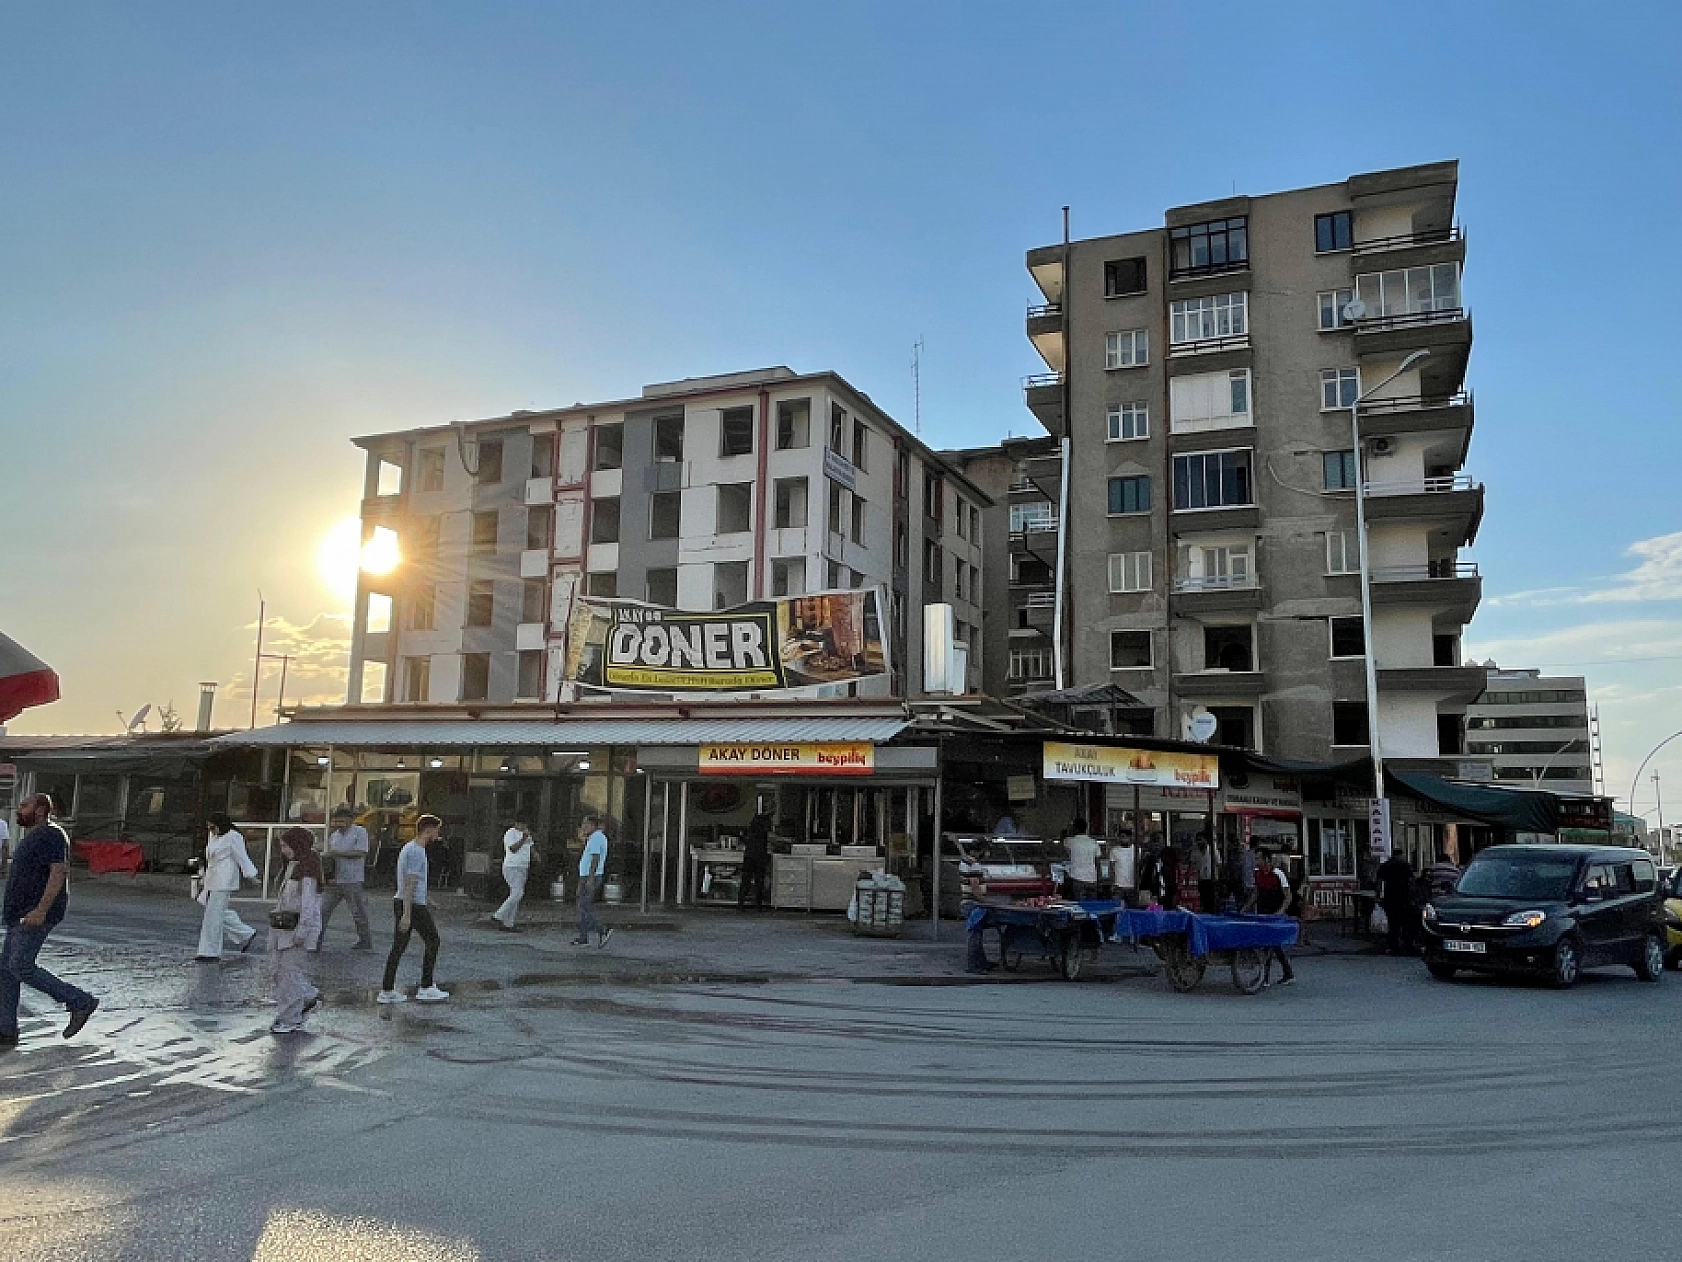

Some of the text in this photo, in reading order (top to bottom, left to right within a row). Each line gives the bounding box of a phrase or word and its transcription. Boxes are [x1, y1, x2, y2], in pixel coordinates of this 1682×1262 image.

[708, 746, 800, 761] AKAY DÖNER
[1055, 761, 1116, 778] TAVUKÇULUK
[1371, 800, 1383, 844] KASAP
